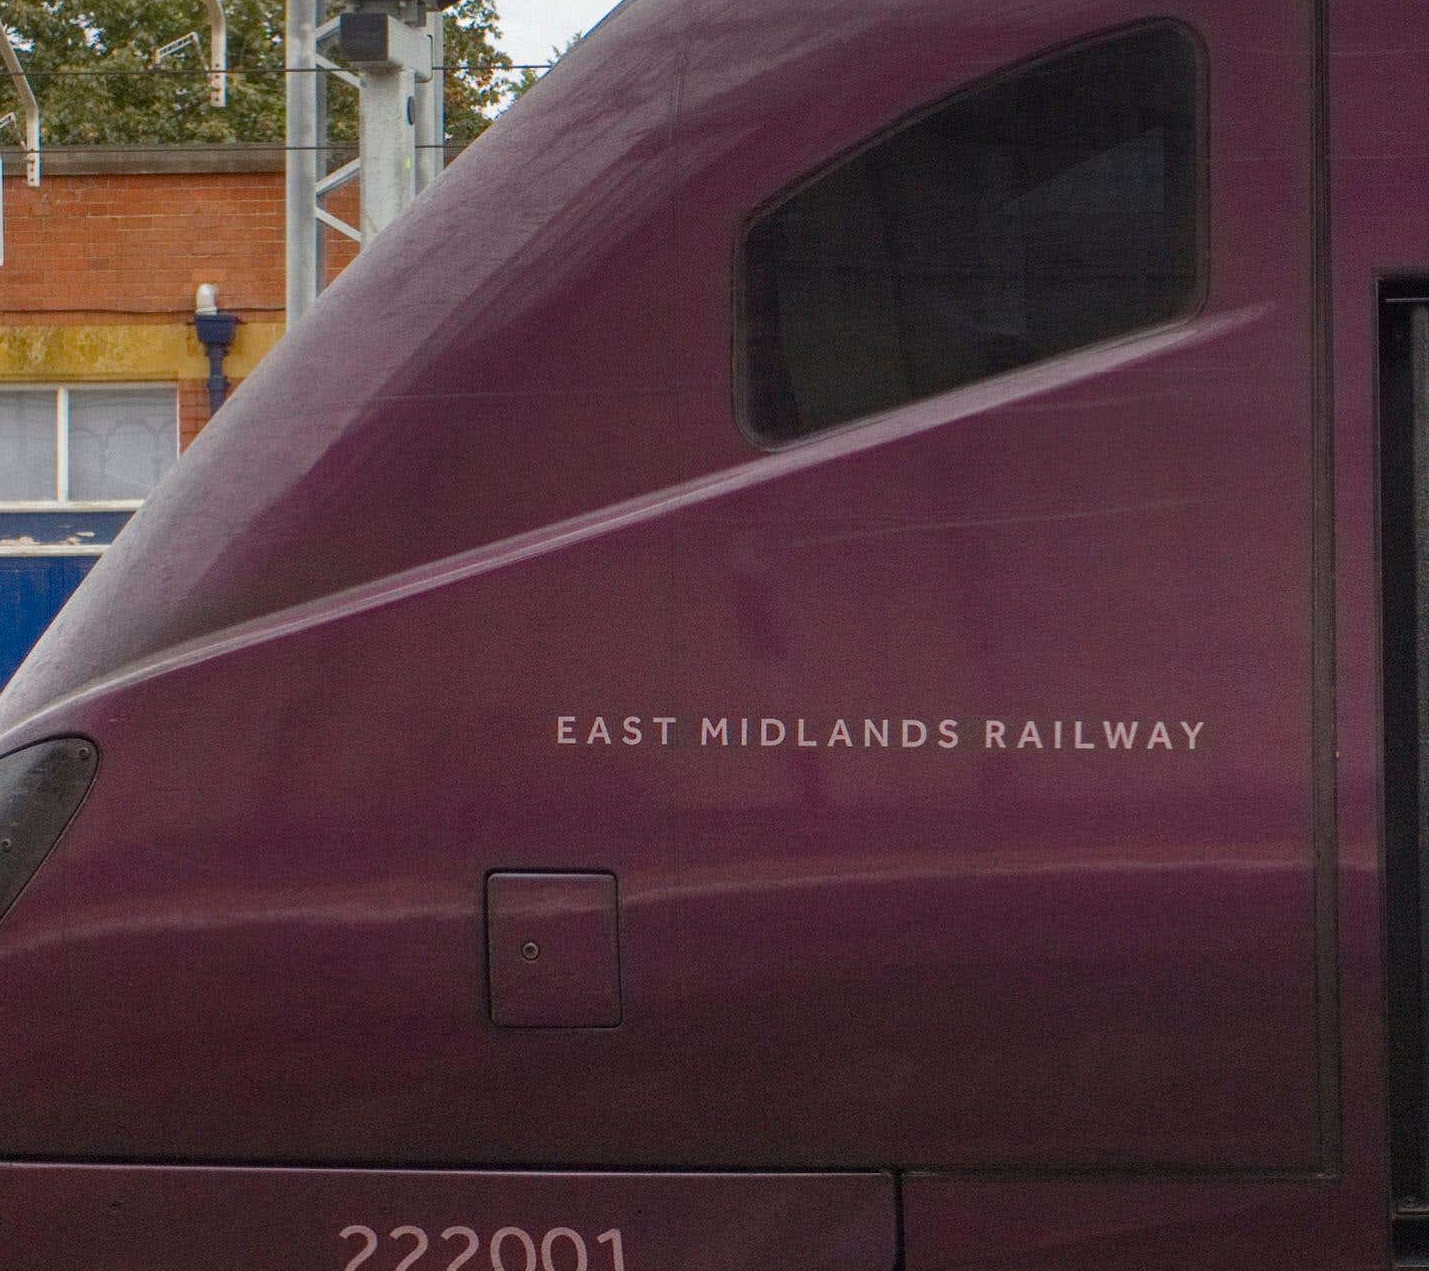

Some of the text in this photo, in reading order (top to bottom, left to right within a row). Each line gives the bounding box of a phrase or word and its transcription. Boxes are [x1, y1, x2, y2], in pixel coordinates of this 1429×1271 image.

[557, 716, 1206, 749] EAST MIDLANDS RAILWAY
